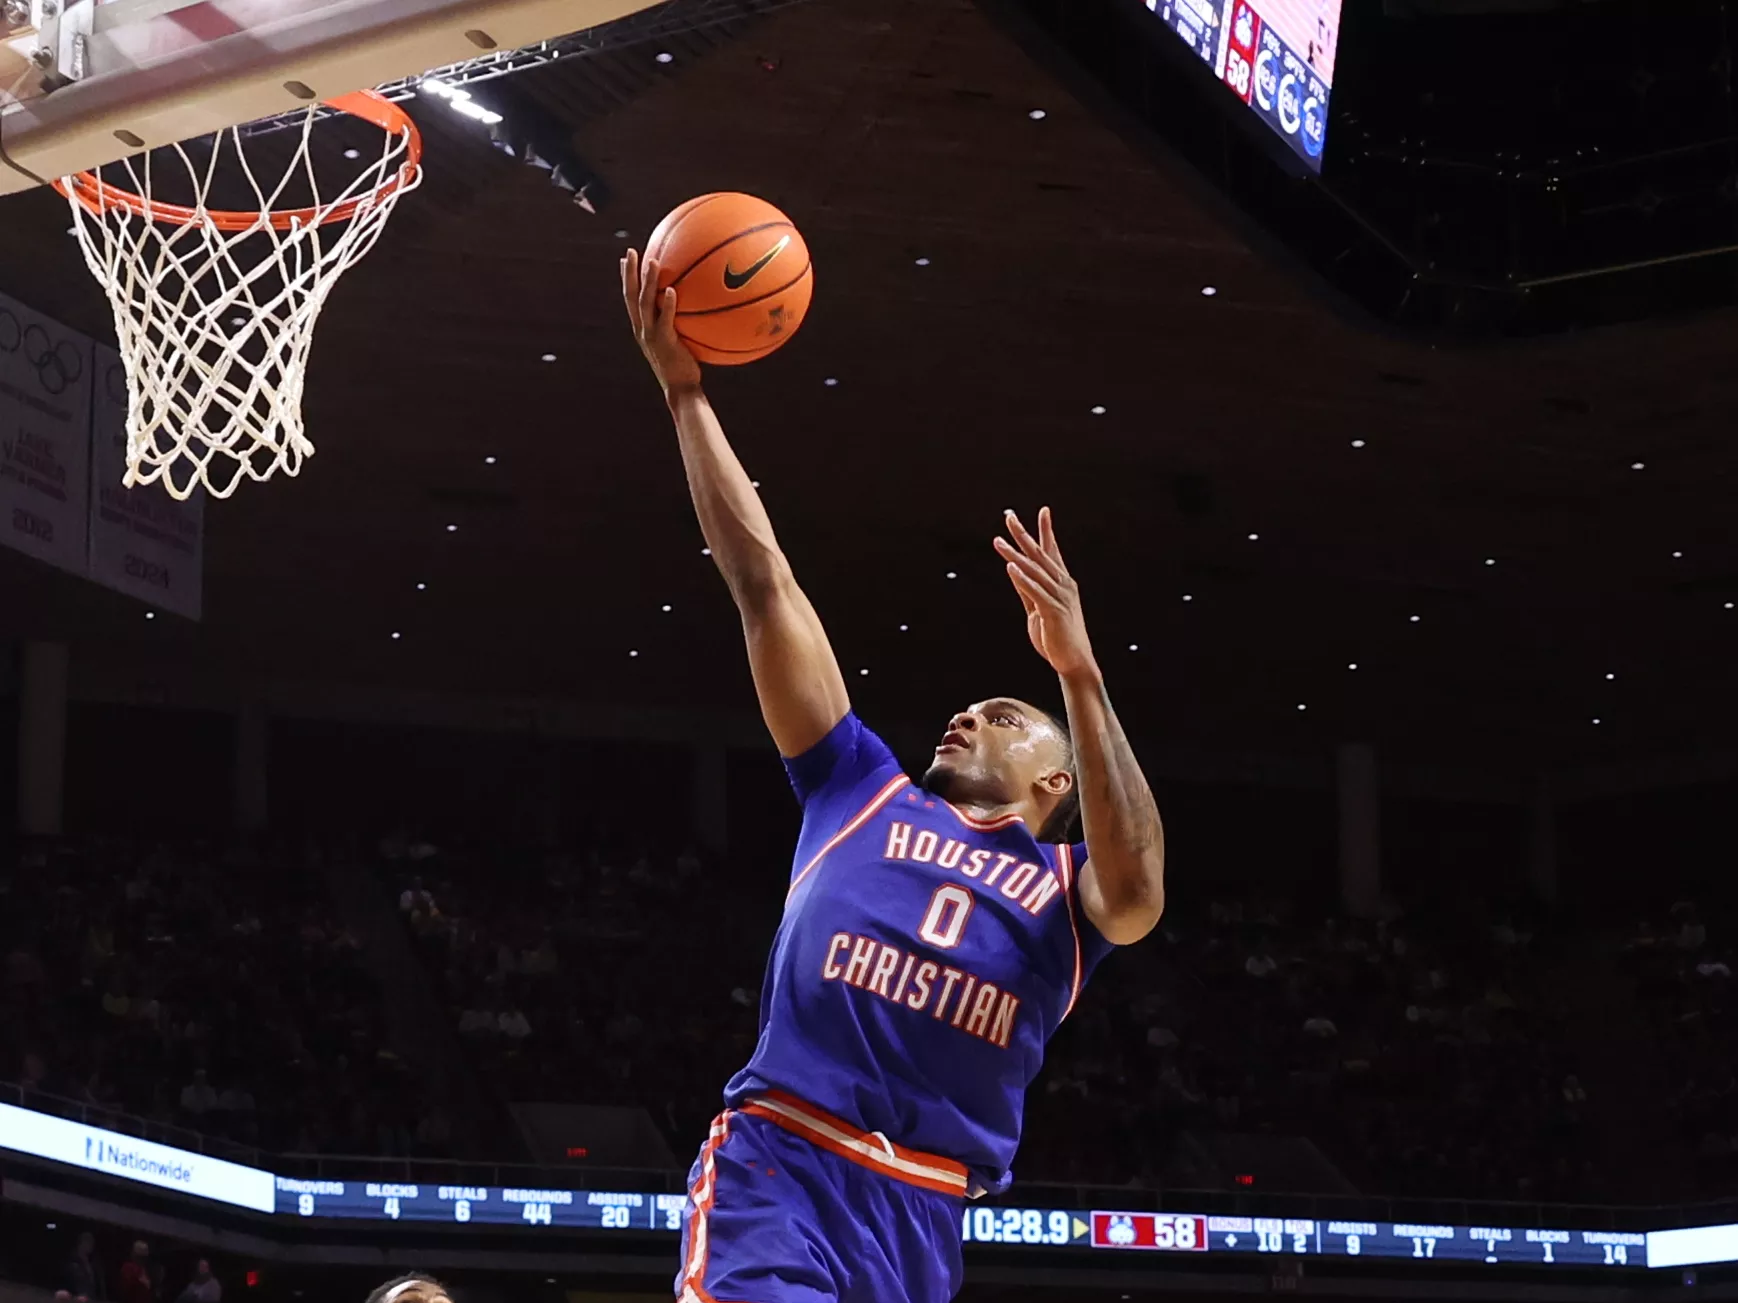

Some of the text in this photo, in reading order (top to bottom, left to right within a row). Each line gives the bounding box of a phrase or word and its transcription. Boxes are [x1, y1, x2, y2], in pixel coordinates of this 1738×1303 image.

[1227, 48, 1250, 96] 58
[884, 821, 1061, 917] HOUSTON
[917, 882, 975, 949] 0
[822, 931, 1020, 1049] CHRISTIAN
[107, 1144, 192, 1183] Nationwide
[276, 1177, 345, 1196] TURNOVERS
[366, 1183, 419, 1198] BLOCKS
[438, 1186, 488, 1201] STEALS
[503, 1188, 573, 1204] REBOUNDS
[588, 1192, 643, 1207] ASSISTS
[298, 1194, 314, 1216] 9
[384, 1198, 400, 1219] 4
[455, 1200, 471, 1222] 6
[522, 1203, 552, 1225] 44
[601, 1206, 630, 1228] 20
[962, 1207, 1070, 1245] 10:28.9
[1154, 1215, 1197, 1249] 58
[1257, 1233, 1307, 1253] 10 2
[1328, 1221, 1645, 1246] ASSISTS REBOUNDS STEALS BLOCKS TURNOVERS
[1346, 1235, 1627, 1265] 9 17 1 14
